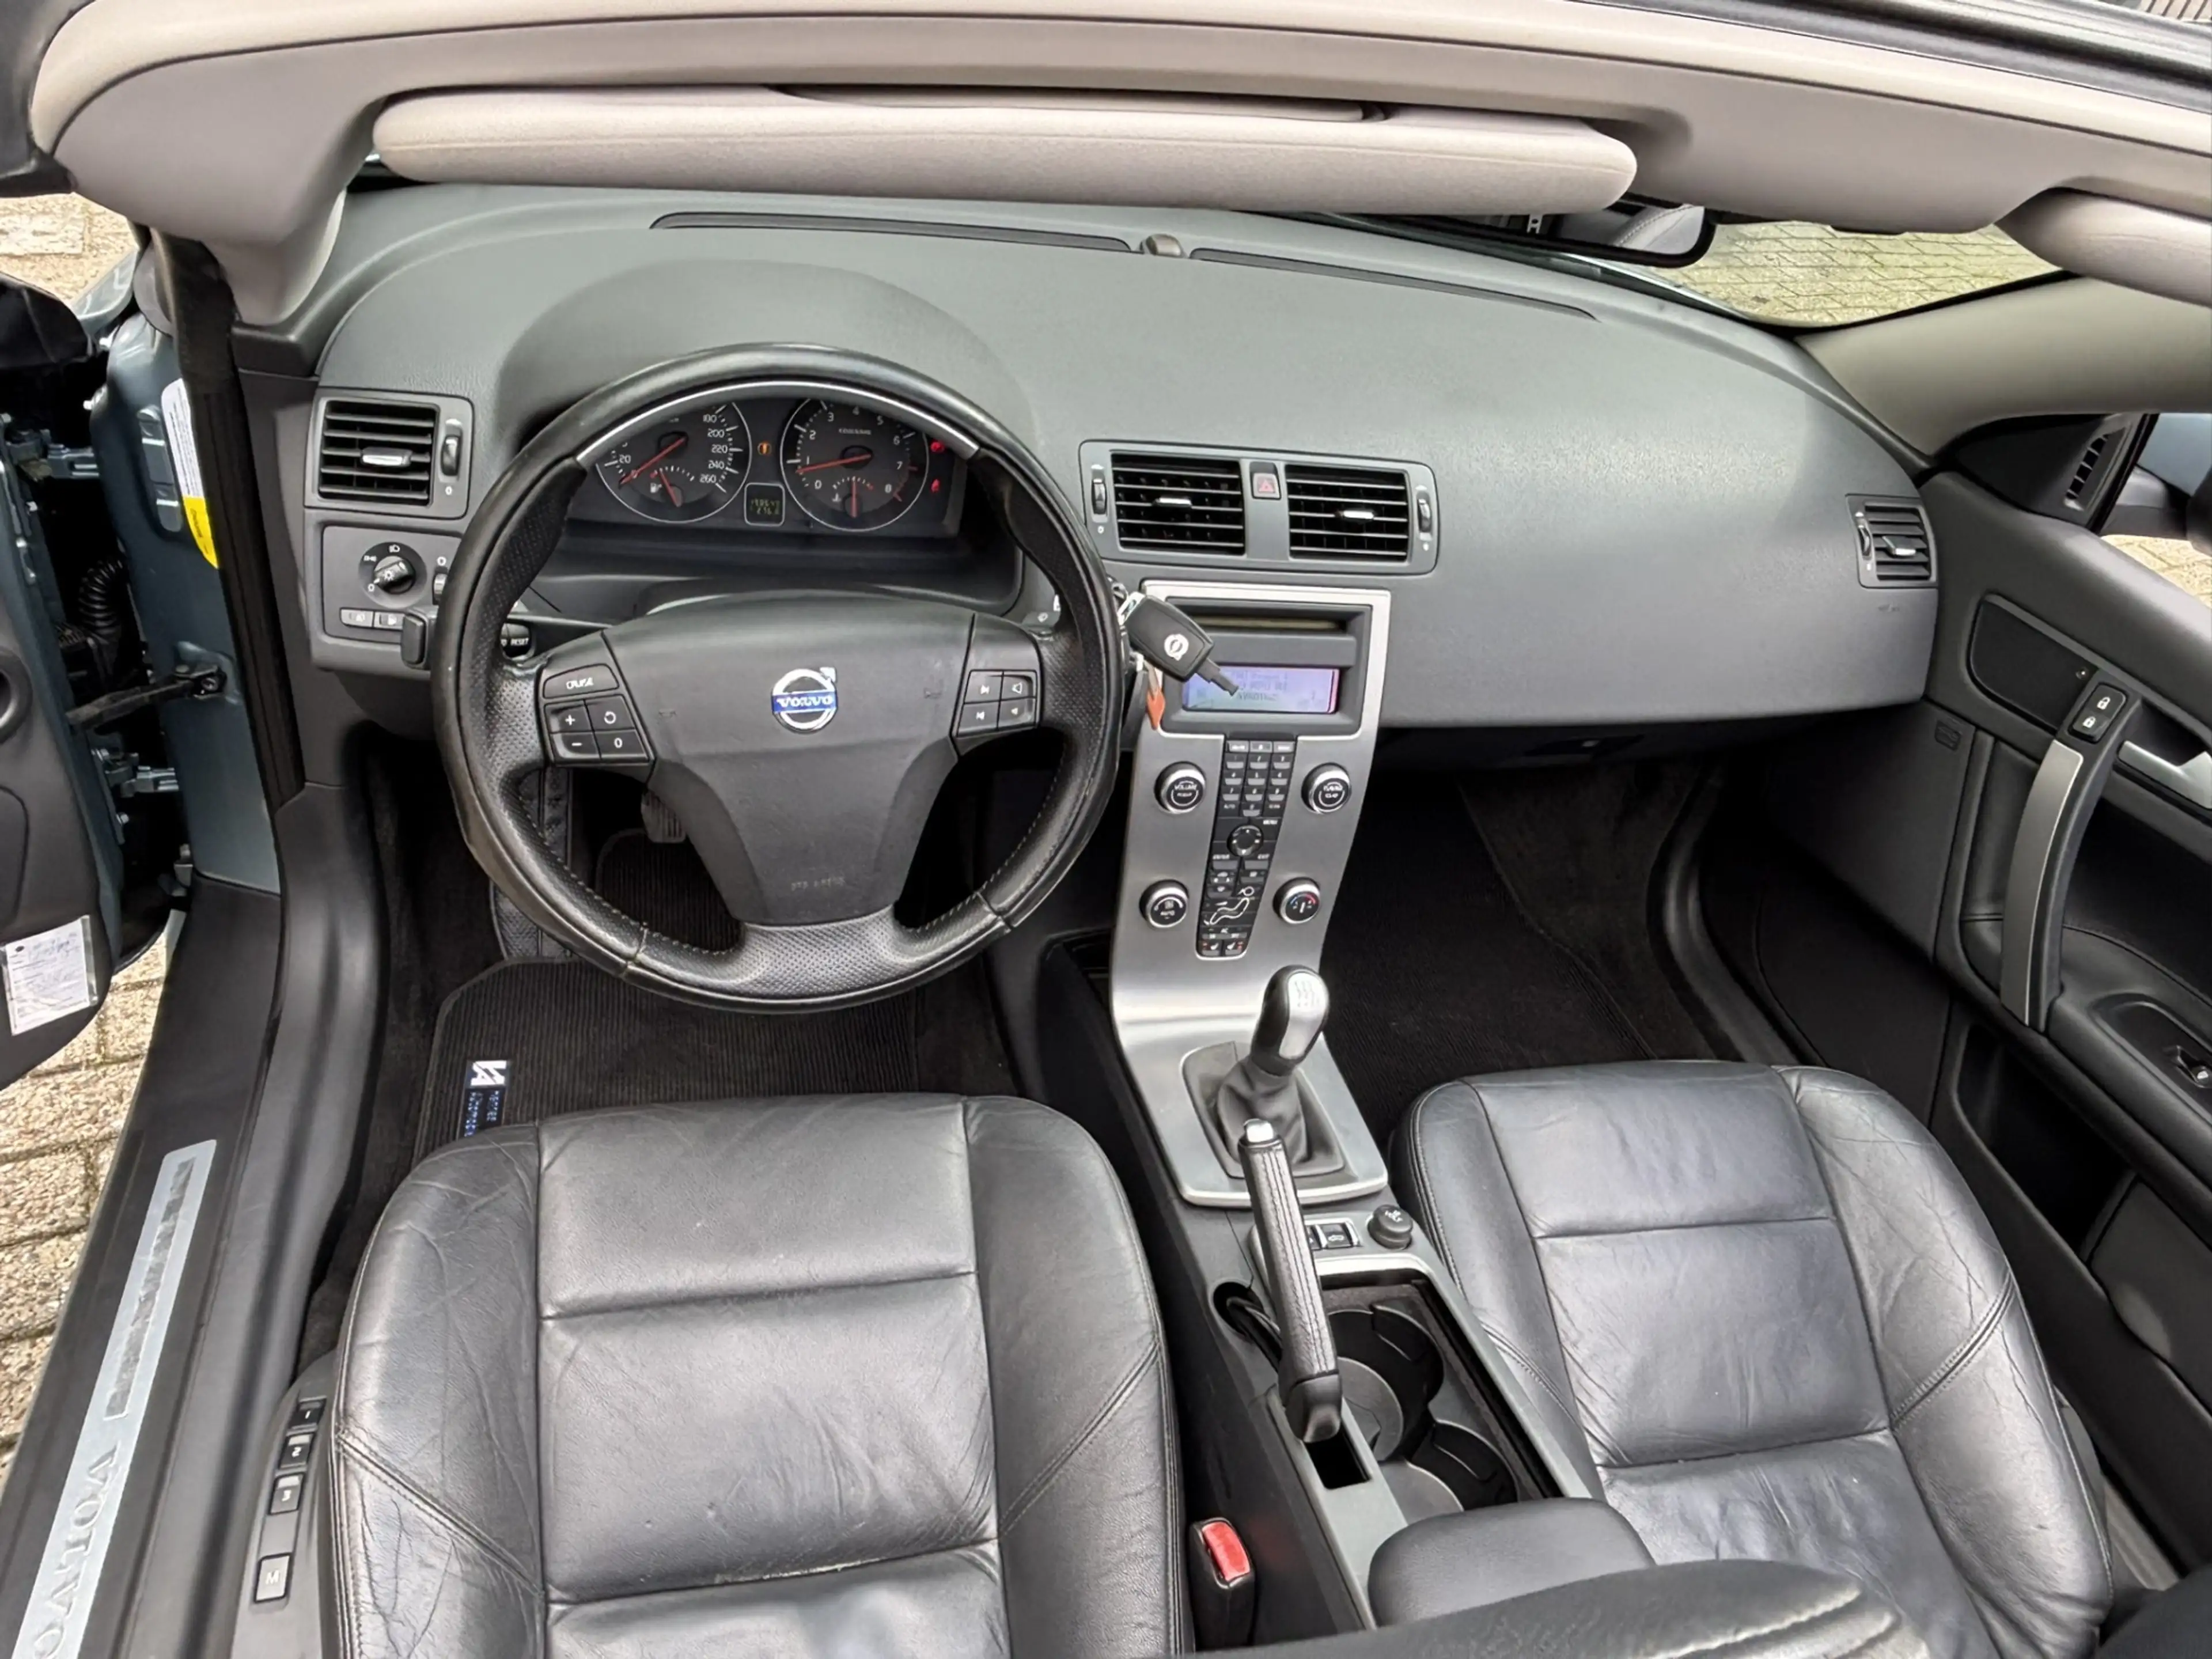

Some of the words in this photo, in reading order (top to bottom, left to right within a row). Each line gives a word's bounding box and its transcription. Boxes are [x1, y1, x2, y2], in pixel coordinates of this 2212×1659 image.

[827, 412, 834, 422] 3
[707, 428, 725, 438] 200
[809, 430, 817, 440] 2
[711, 444, 728, 454] 220
[708, 460, 725, 470] 240
[896, 461, 903, 470] 7
[699, 473, 717, 484] 260
[814, 479, 823, 490] 0
[777, 695, 833, 708] VOLVO
[292, 1446, 302, 1457] 2
[265, 1570, 280, 1585] M
